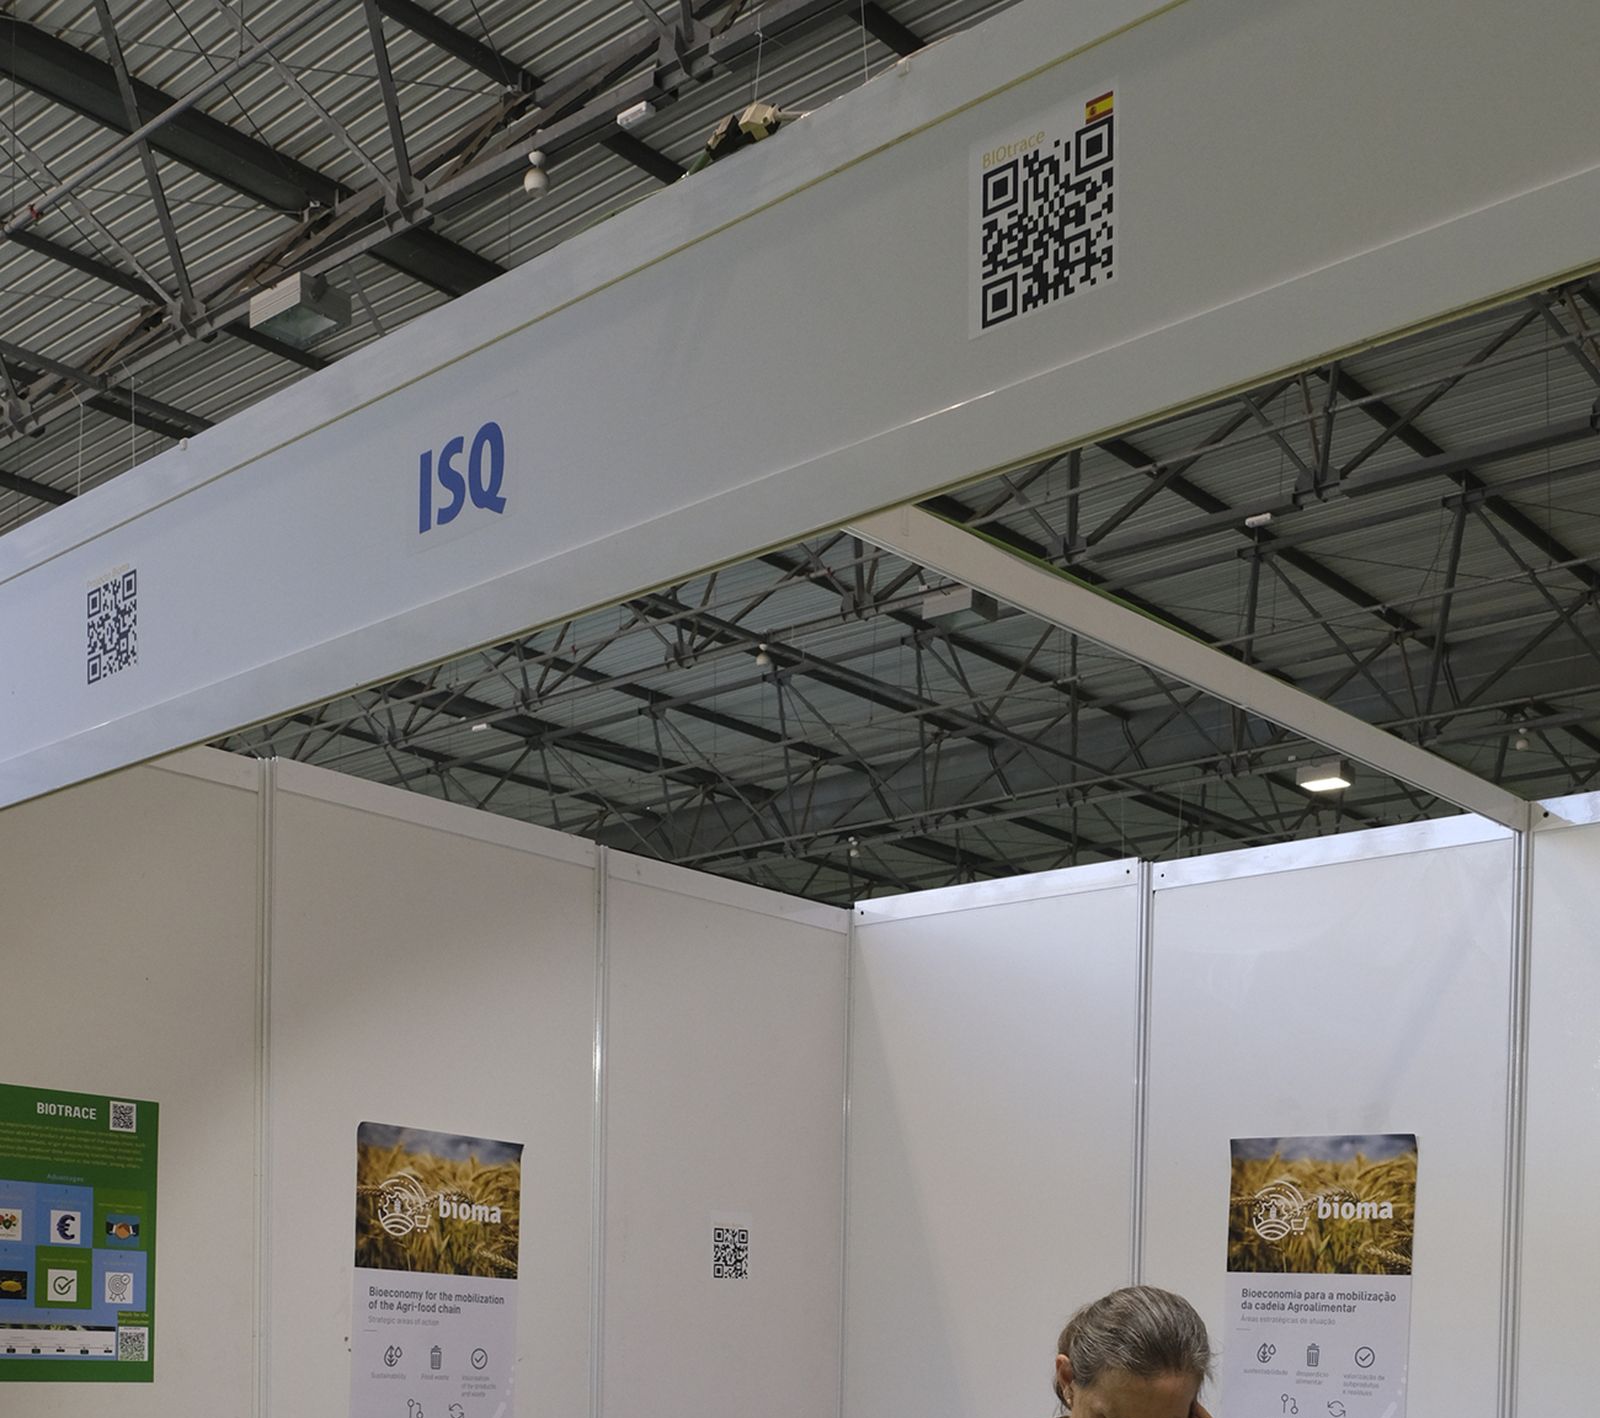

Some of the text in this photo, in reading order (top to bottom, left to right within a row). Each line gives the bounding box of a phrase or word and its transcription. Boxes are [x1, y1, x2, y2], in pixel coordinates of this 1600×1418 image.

[982, 129, 1045, 169] BIOtrace
[419, 421, 507, 534] ISQ
[36, 1102, 97, 1120] BIOTRACE
[439, 1193, 502, 1224] bioma
[1317, 1196, 1393, 1220] bioma
[368, 1286, 504, 1305] Bioeconomy for the mobilization
[1241, 1288, 1396, 1303] Bioeconomia para a mobilização
[368, 1300, 461, 1314] of the Agri-food chain
[1241, 1300, 1356, 1313] da cadeia Agroalimentar
[1240, 1314, 1258, 1324] Áreas
[1300, 1316, 1308, 1324] de
